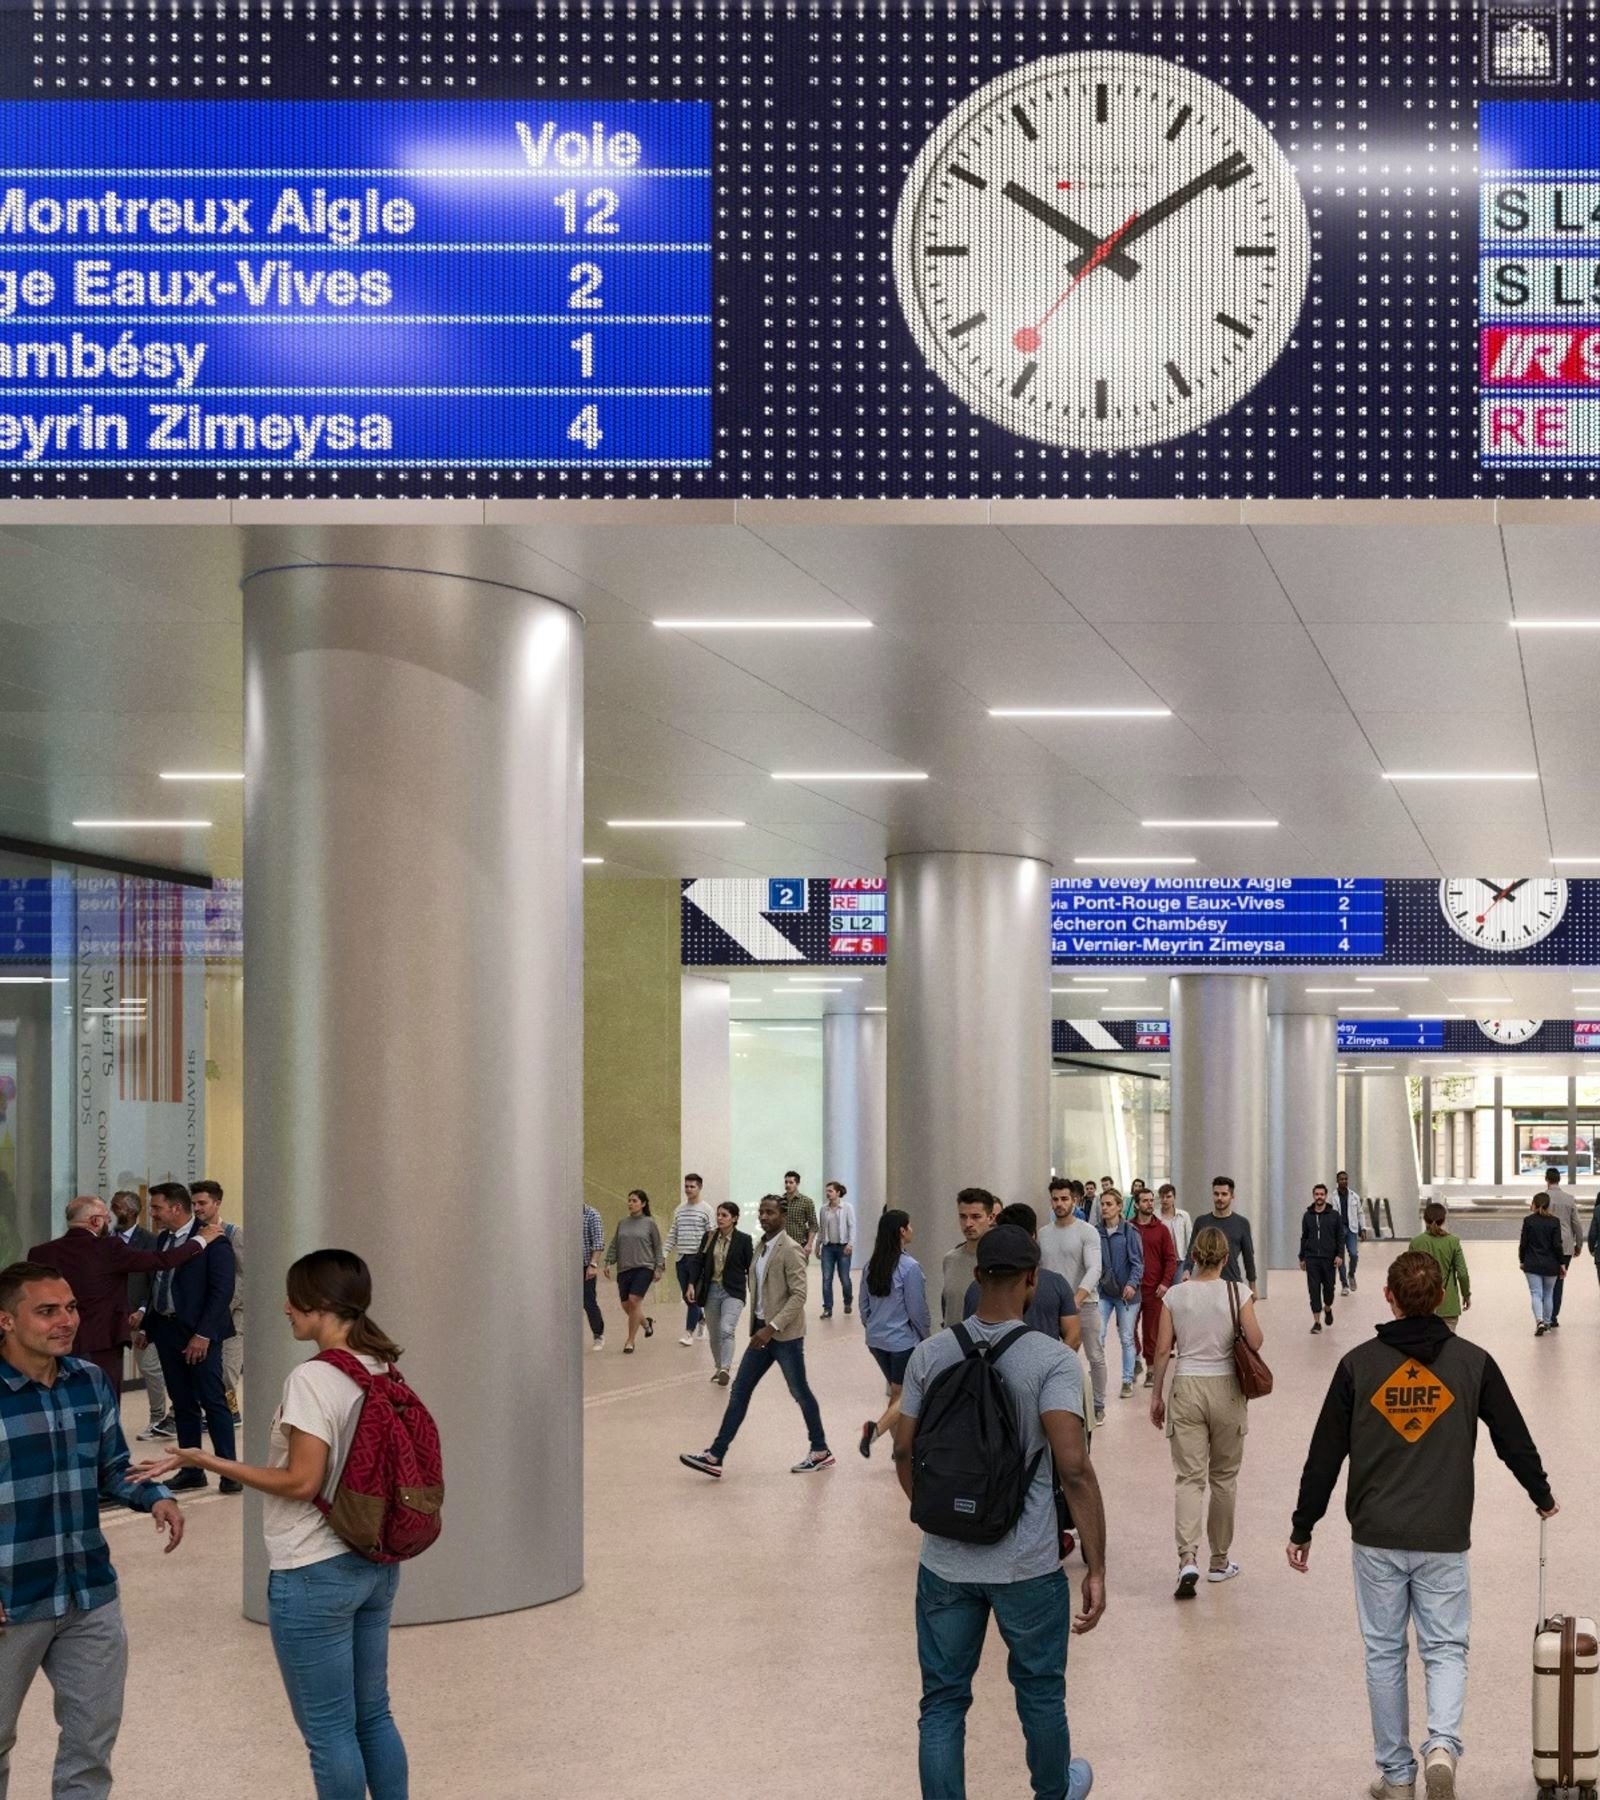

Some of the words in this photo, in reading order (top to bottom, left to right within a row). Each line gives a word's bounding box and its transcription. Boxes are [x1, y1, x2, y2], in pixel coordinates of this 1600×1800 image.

[515, 122, 641, 168] Voie
[267, 187, 417, 248] Aigle
[553, 187, 621, 233] 12
[1494, 189, 1530, 233] S
[74, 260, 392, 307] Eaux-Vives
[569, 262, 603, 308] 2
[1494, 264, 1530, 307] S
[571, 333, 593, 377] 1
[147, 404, 393, 462] Zimeysa
[567, 405, 603, 449] 4
[1491, 408, 1568, 448] RE
[780, 888, 794, 905] 2
[832, 896, 857, 909] RE
[1050, 898, 1068, 910] via
[1073, 895, 1181, 913] Pont-Rouge
[1186, 895, 1285, 910] Eaux-Vives
[1338, 896, 1350, 911] 2
[1098, 878, 1150, 893] Vevey
[1155, 878, 1243, 889] Montreux
[1247, 878, 1293, 893] Aigle
[1336, 878, 1356, 889] 12
[831, 917, 844, 930] S
[850, 917, 873, 930] L2
[1050, 916, 1127, 932] écheron
[1132, 916, 1228, 935] Chambésy
[1339, 917, 1348, 931] 1
[861, 938, 873, 953] 5
[1073, 937, 1204, 956] Vernier-Meyrin
[1209, 937, 1285, 956] Zimeysa
[1338, 938, 1350, 952] 4
[103, 969, 115, 1078] SWEETS
[1346, 1035, 1389, 1047] Zimeysa
[1417, 1035, 1425, 1045] 4
[81, 1043, 93, 1126] FOODS
[186, 1049, 195, 1138] SHAVING
[1385, 1385, 1441, 1407] SURF
